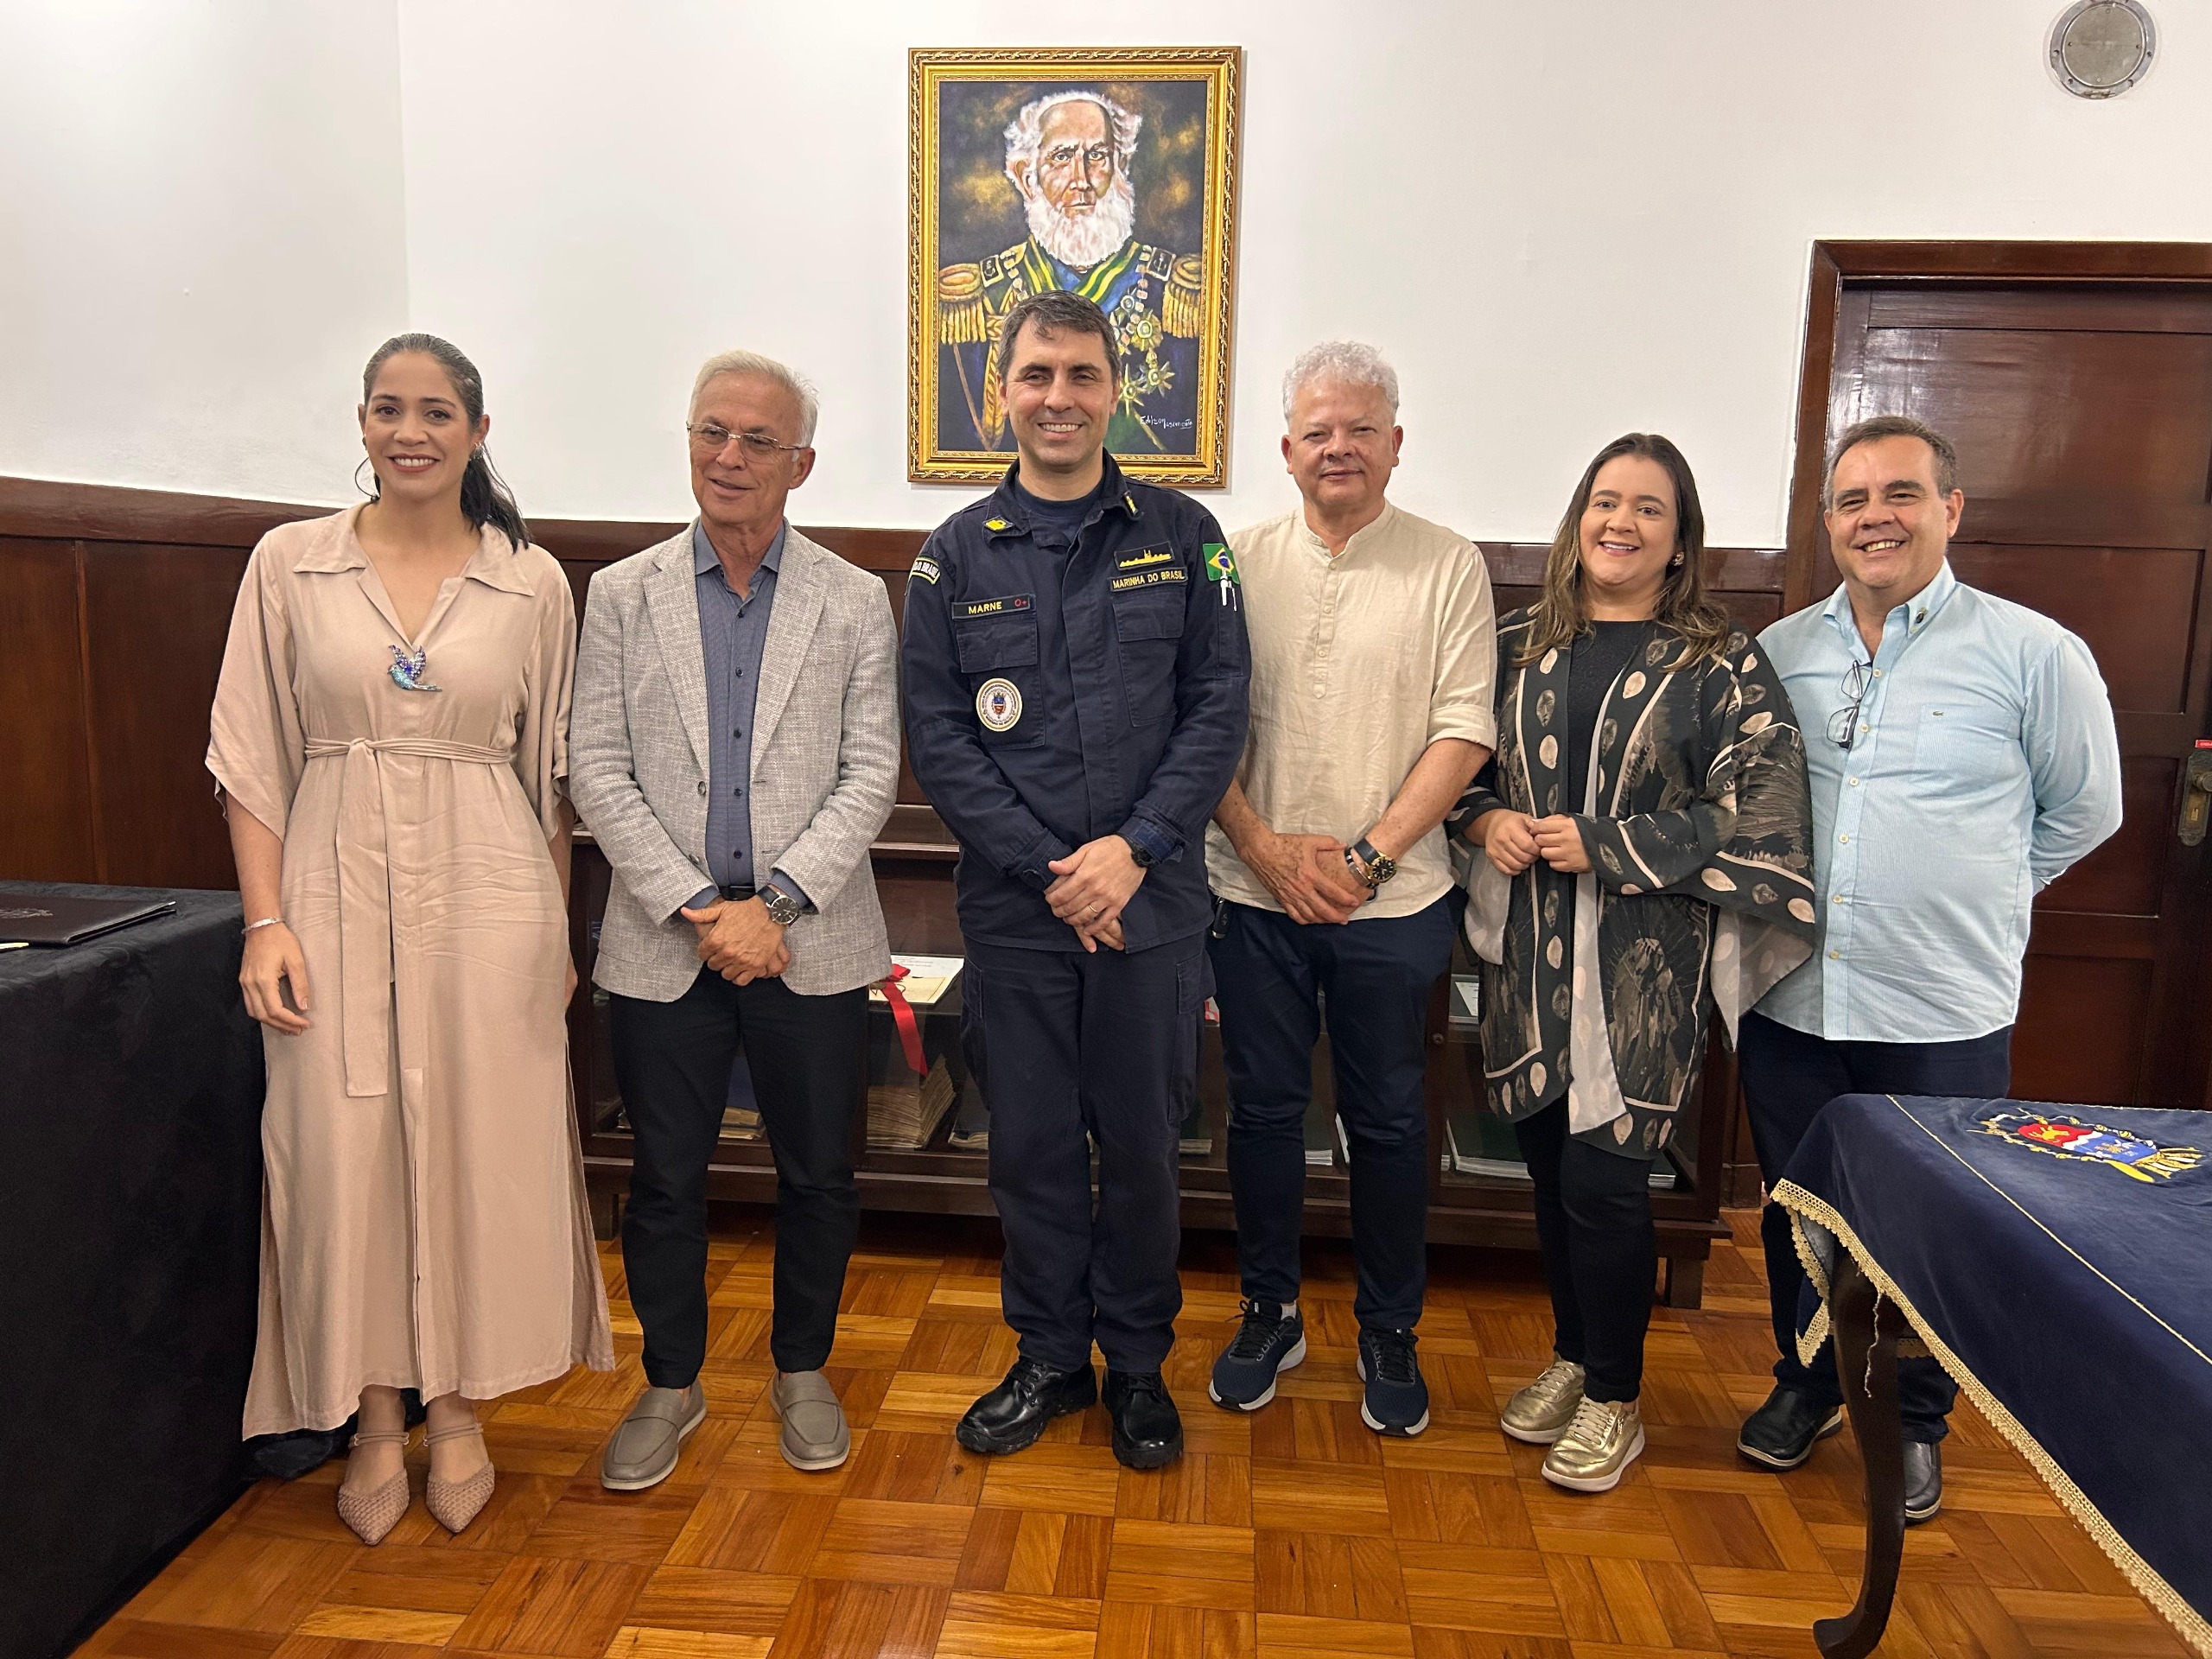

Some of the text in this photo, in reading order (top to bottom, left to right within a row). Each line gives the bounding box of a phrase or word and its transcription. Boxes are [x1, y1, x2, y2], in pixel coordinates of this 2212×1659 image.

[1112, 569, 1185, 589] MARINHA DO BRASIL
[968, 601, 1002, 614] MARNE
